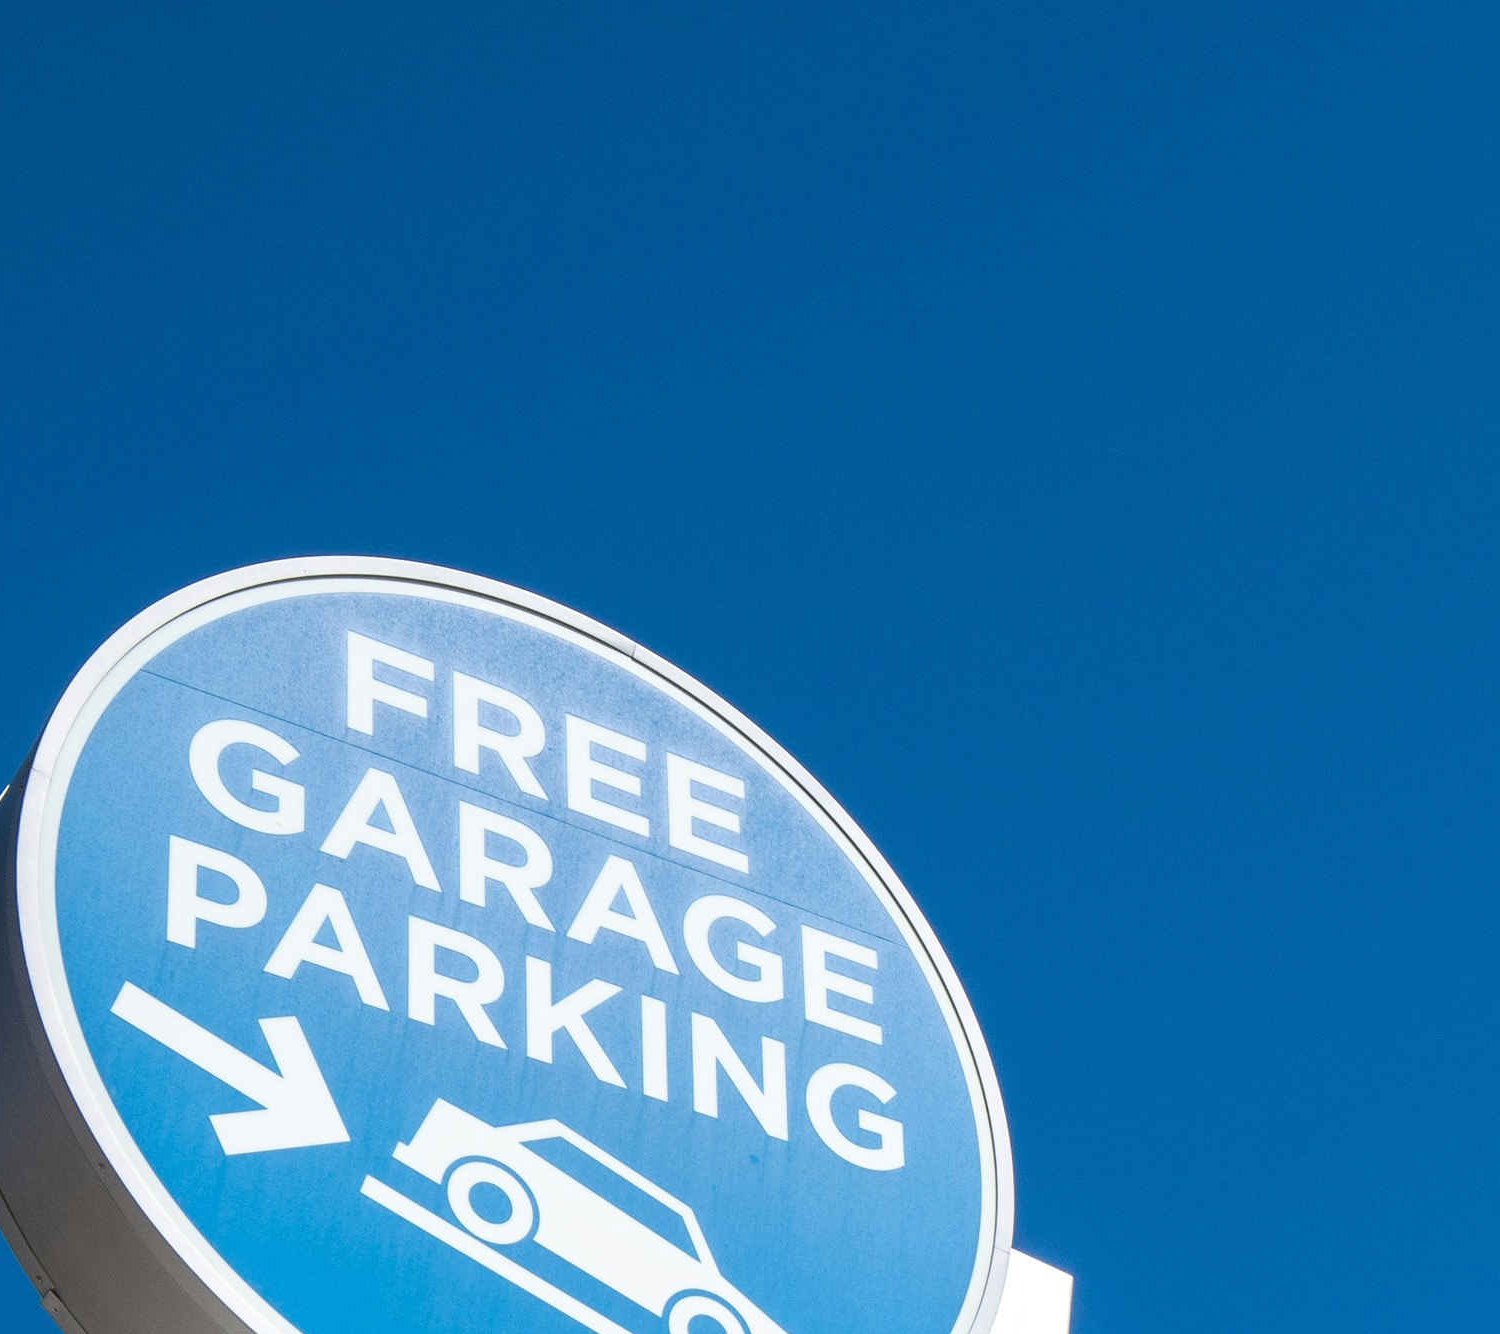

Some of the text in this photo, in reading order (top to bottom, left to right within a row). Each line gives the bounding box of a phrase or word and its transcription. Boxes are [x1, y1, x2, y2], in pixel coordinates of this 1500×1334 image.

[187, 718, 884, 1045] GARAGE
[345, 631, 750, 874] FREE
[165, 834, 905, 1172] PARKING
